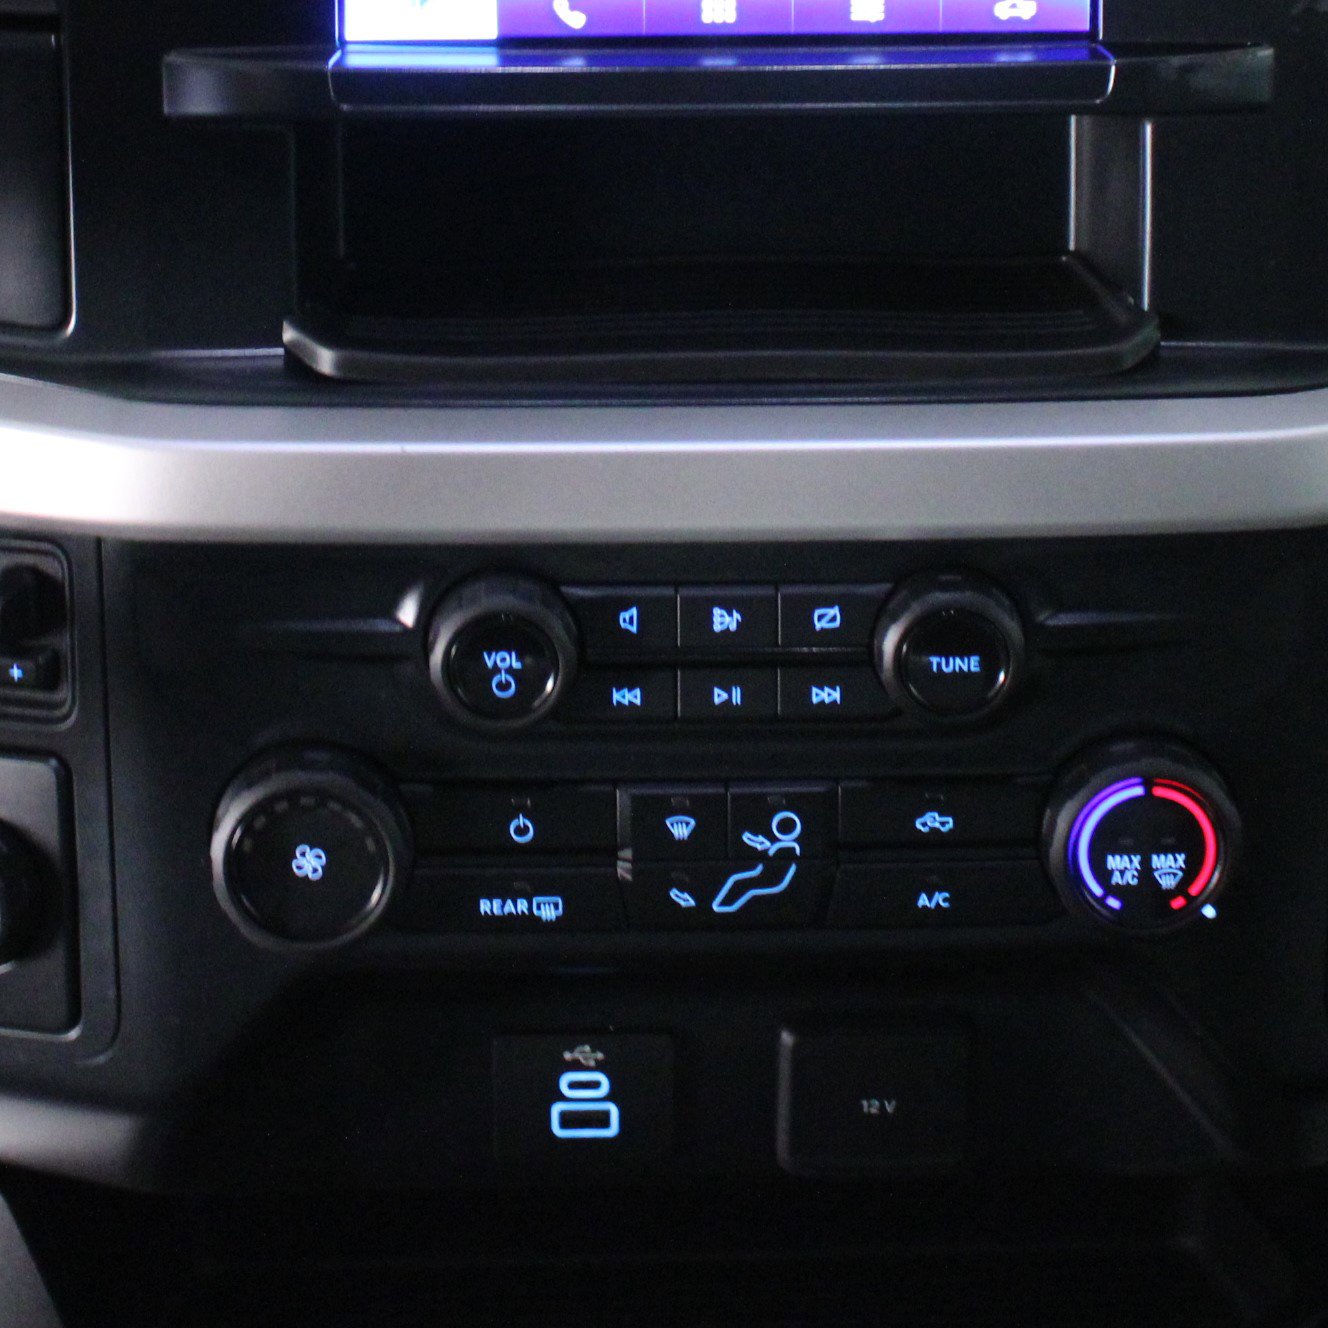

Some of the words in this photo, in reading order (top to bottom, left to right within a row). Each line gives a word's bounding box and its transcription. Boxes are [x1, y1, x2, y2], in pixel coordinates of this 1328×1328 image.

[483, 651, 522, 670] VOL
[928, 655, 981, 674] TUNE
[1106, 854, 1142, 871] MAX
[1151, 853, 1186, 870] MAX
[1110, 869, 1140, 886] A/C
[479, 898, 529, 916] REAR
[917, 891, 950, 909] A/C
[861, 1098, 880, 1114] 12
[882, 1098, 896, 1114] V
